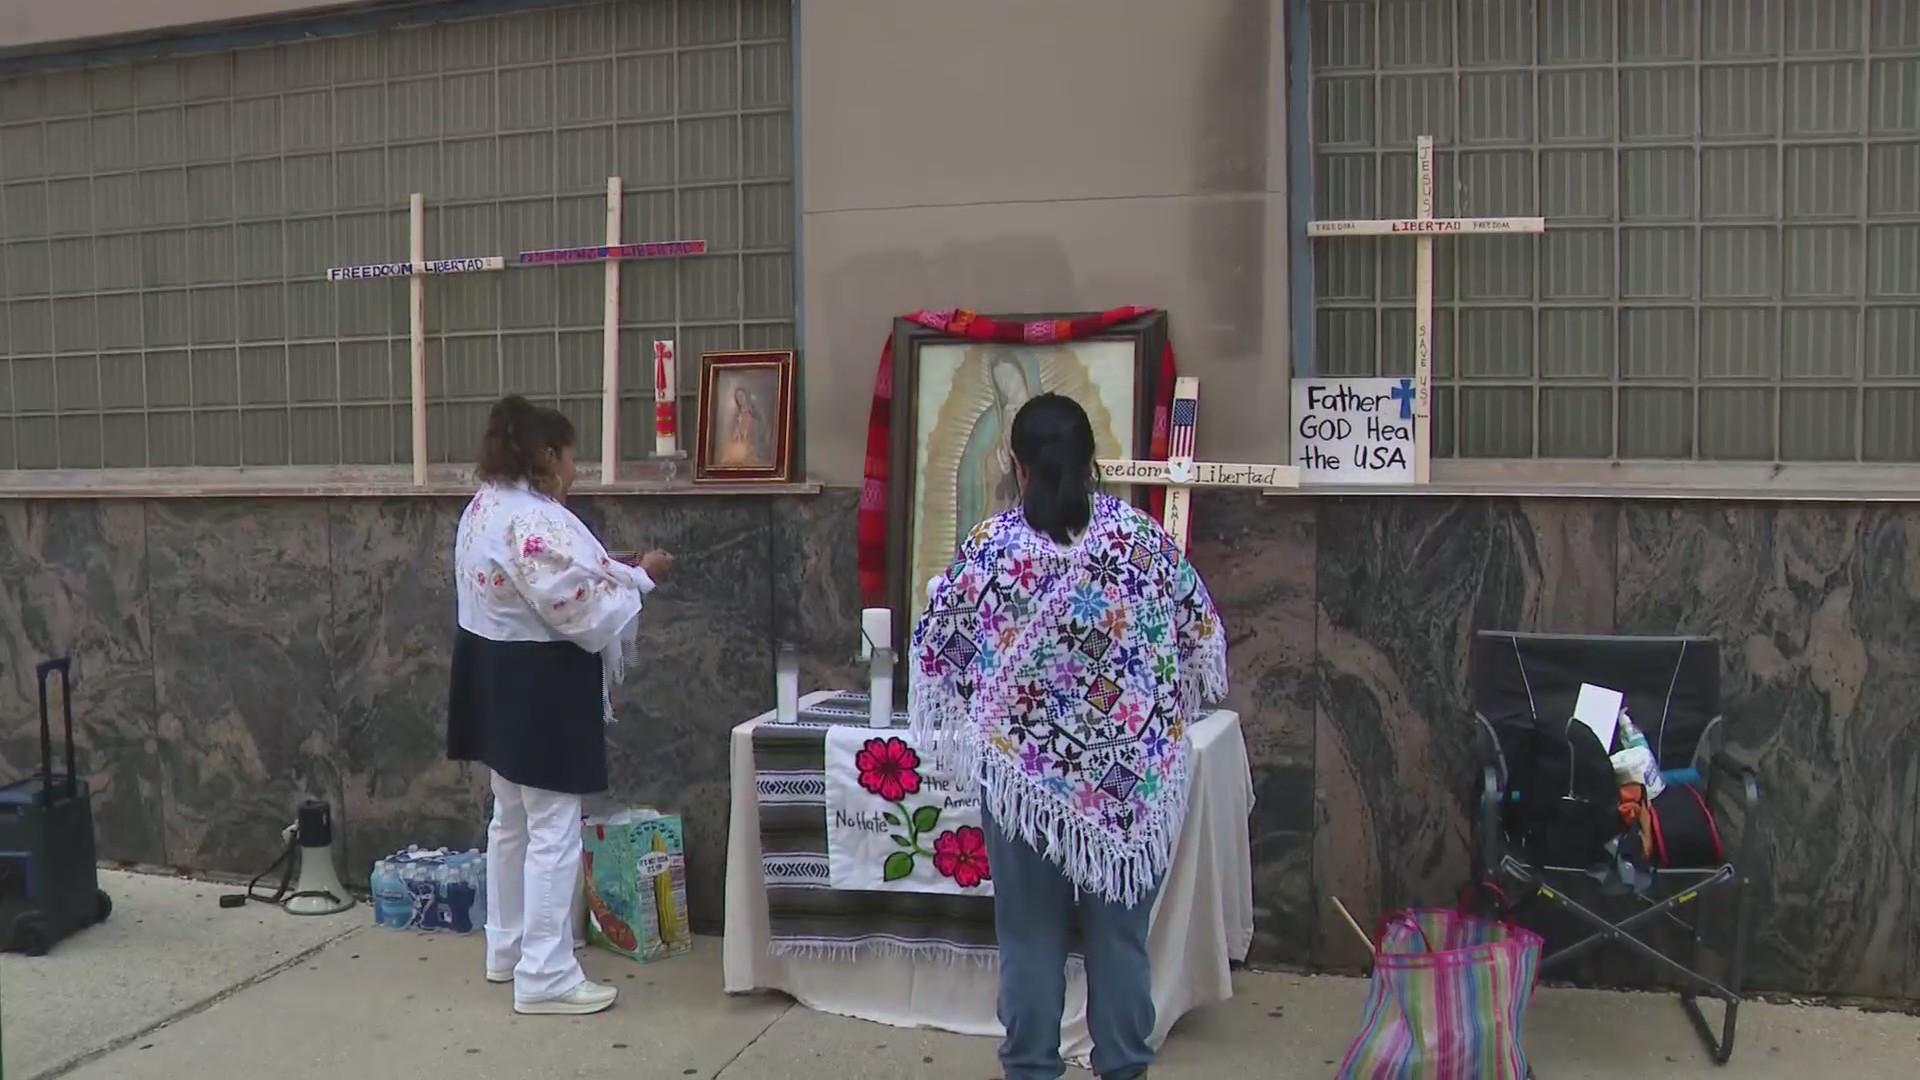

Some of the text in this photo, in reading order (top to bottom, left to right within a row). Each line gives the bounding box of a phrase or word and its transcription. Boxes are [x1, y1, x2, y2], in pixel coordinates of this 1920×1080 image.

[1420, 146, 1431, 213] JESUS
[1316, 221, 1510, 231] FREEDOM LIBERTAD FREEDOM
[424, 259, 483, 272] LIBERTAD
[1419, 325, 1428, 368] SAVE
[1308, 384, 1391, 413] Father
[1300, 415, 1352, 441] GOD
[1300, 444, 1407, 470] the USA
[1195, 465, 1276, 485] Libertad
[923, 775, 950, 792] the
